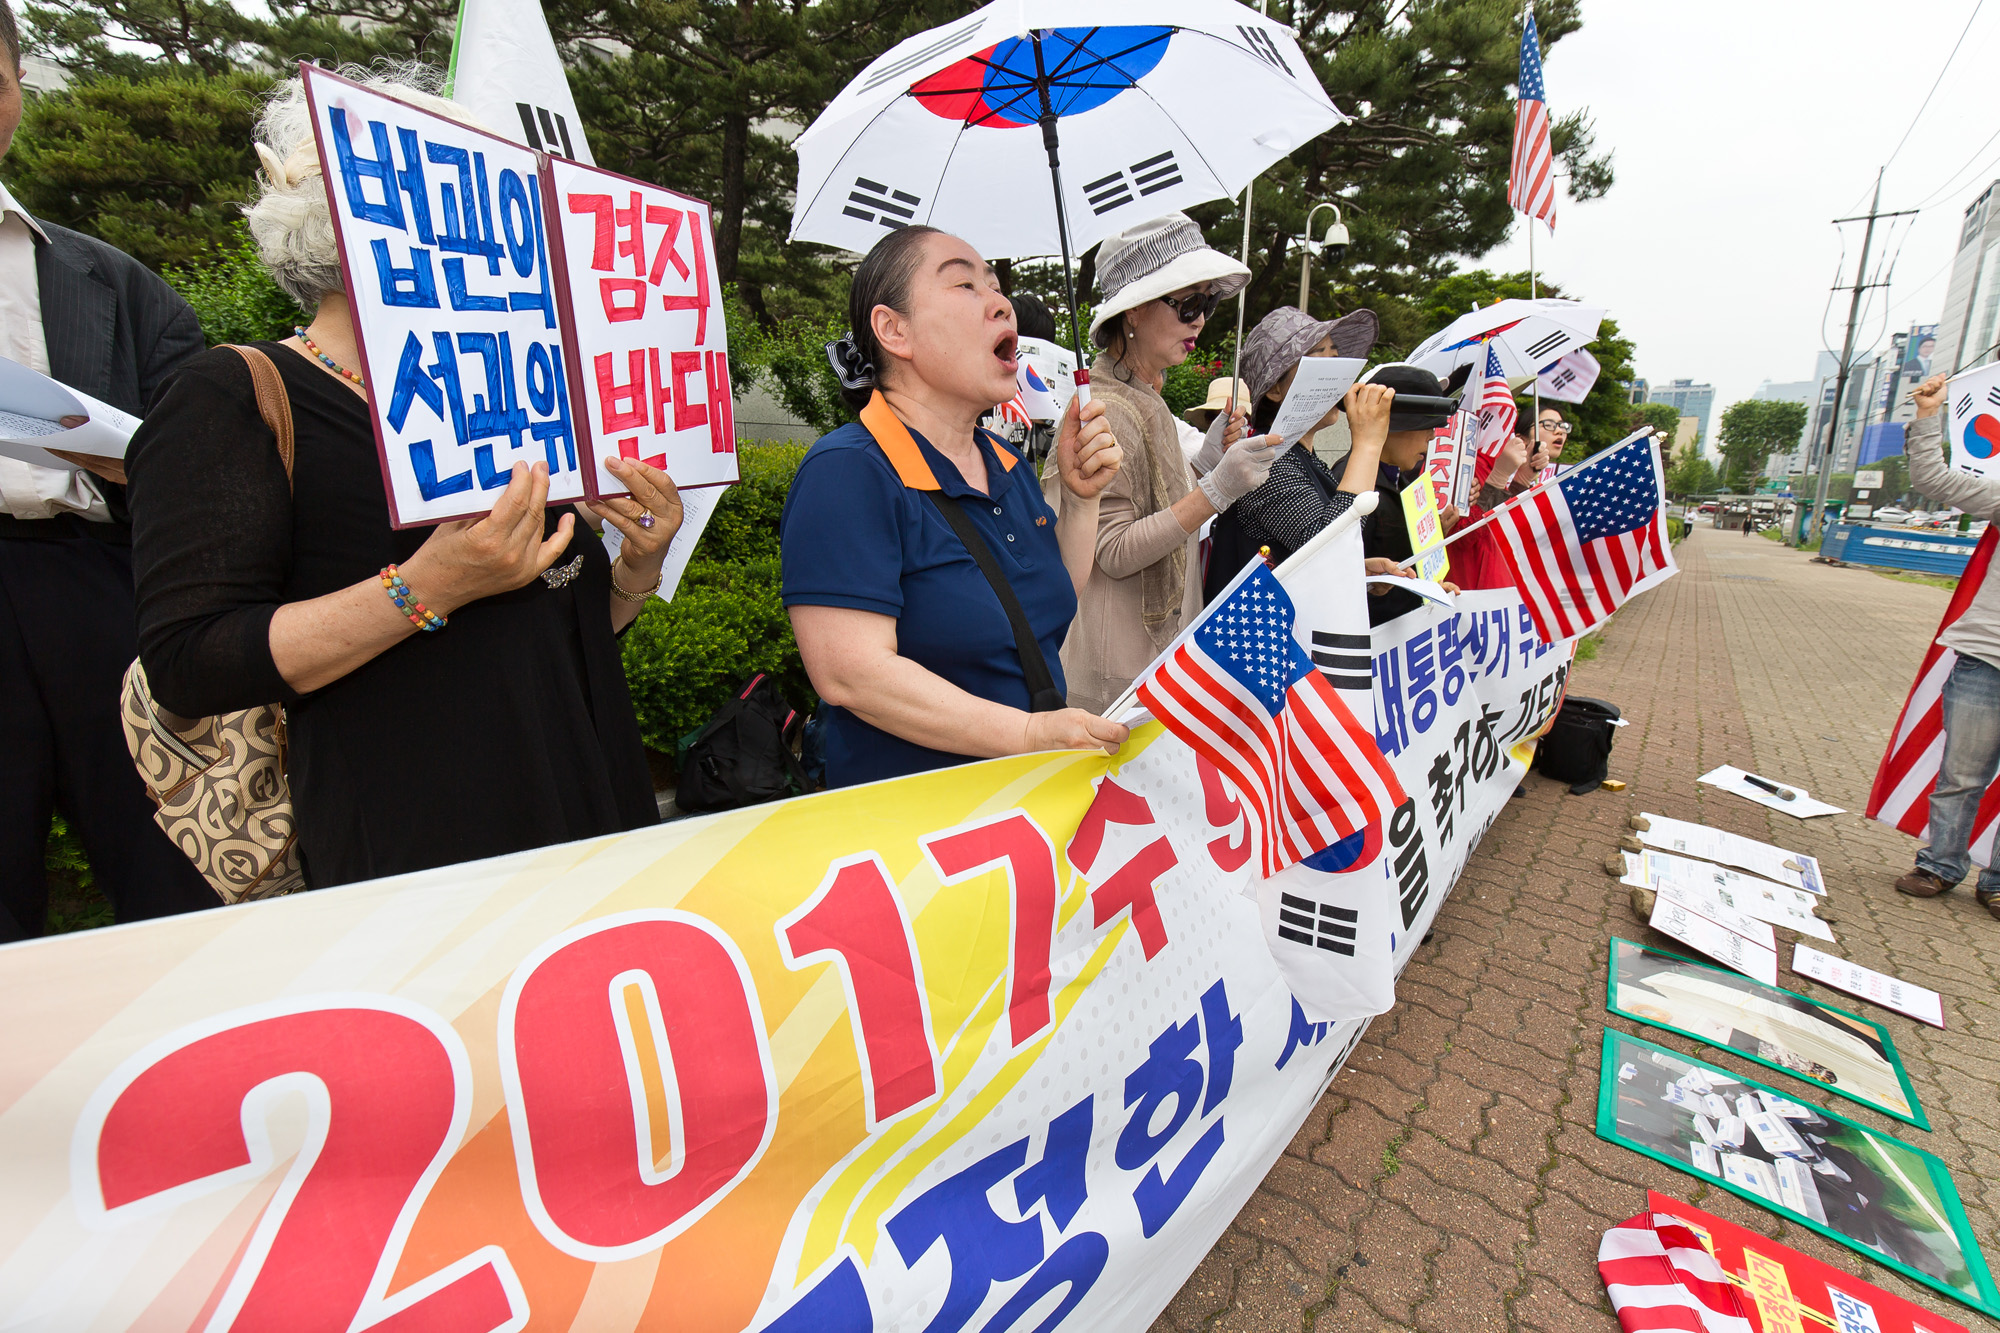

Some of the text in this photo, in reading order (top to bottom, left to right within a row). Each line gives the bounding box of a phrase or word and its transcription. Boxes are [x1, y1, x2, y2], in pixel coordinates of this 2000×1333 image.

[328, 105, 557, 330] 법관의
[567, 190, 711, 347] 겸직
[387, 330, 577, 502] 선관위
[593, 346, 734, 472] 반대
[1517, 602, 1556, 670] 무
